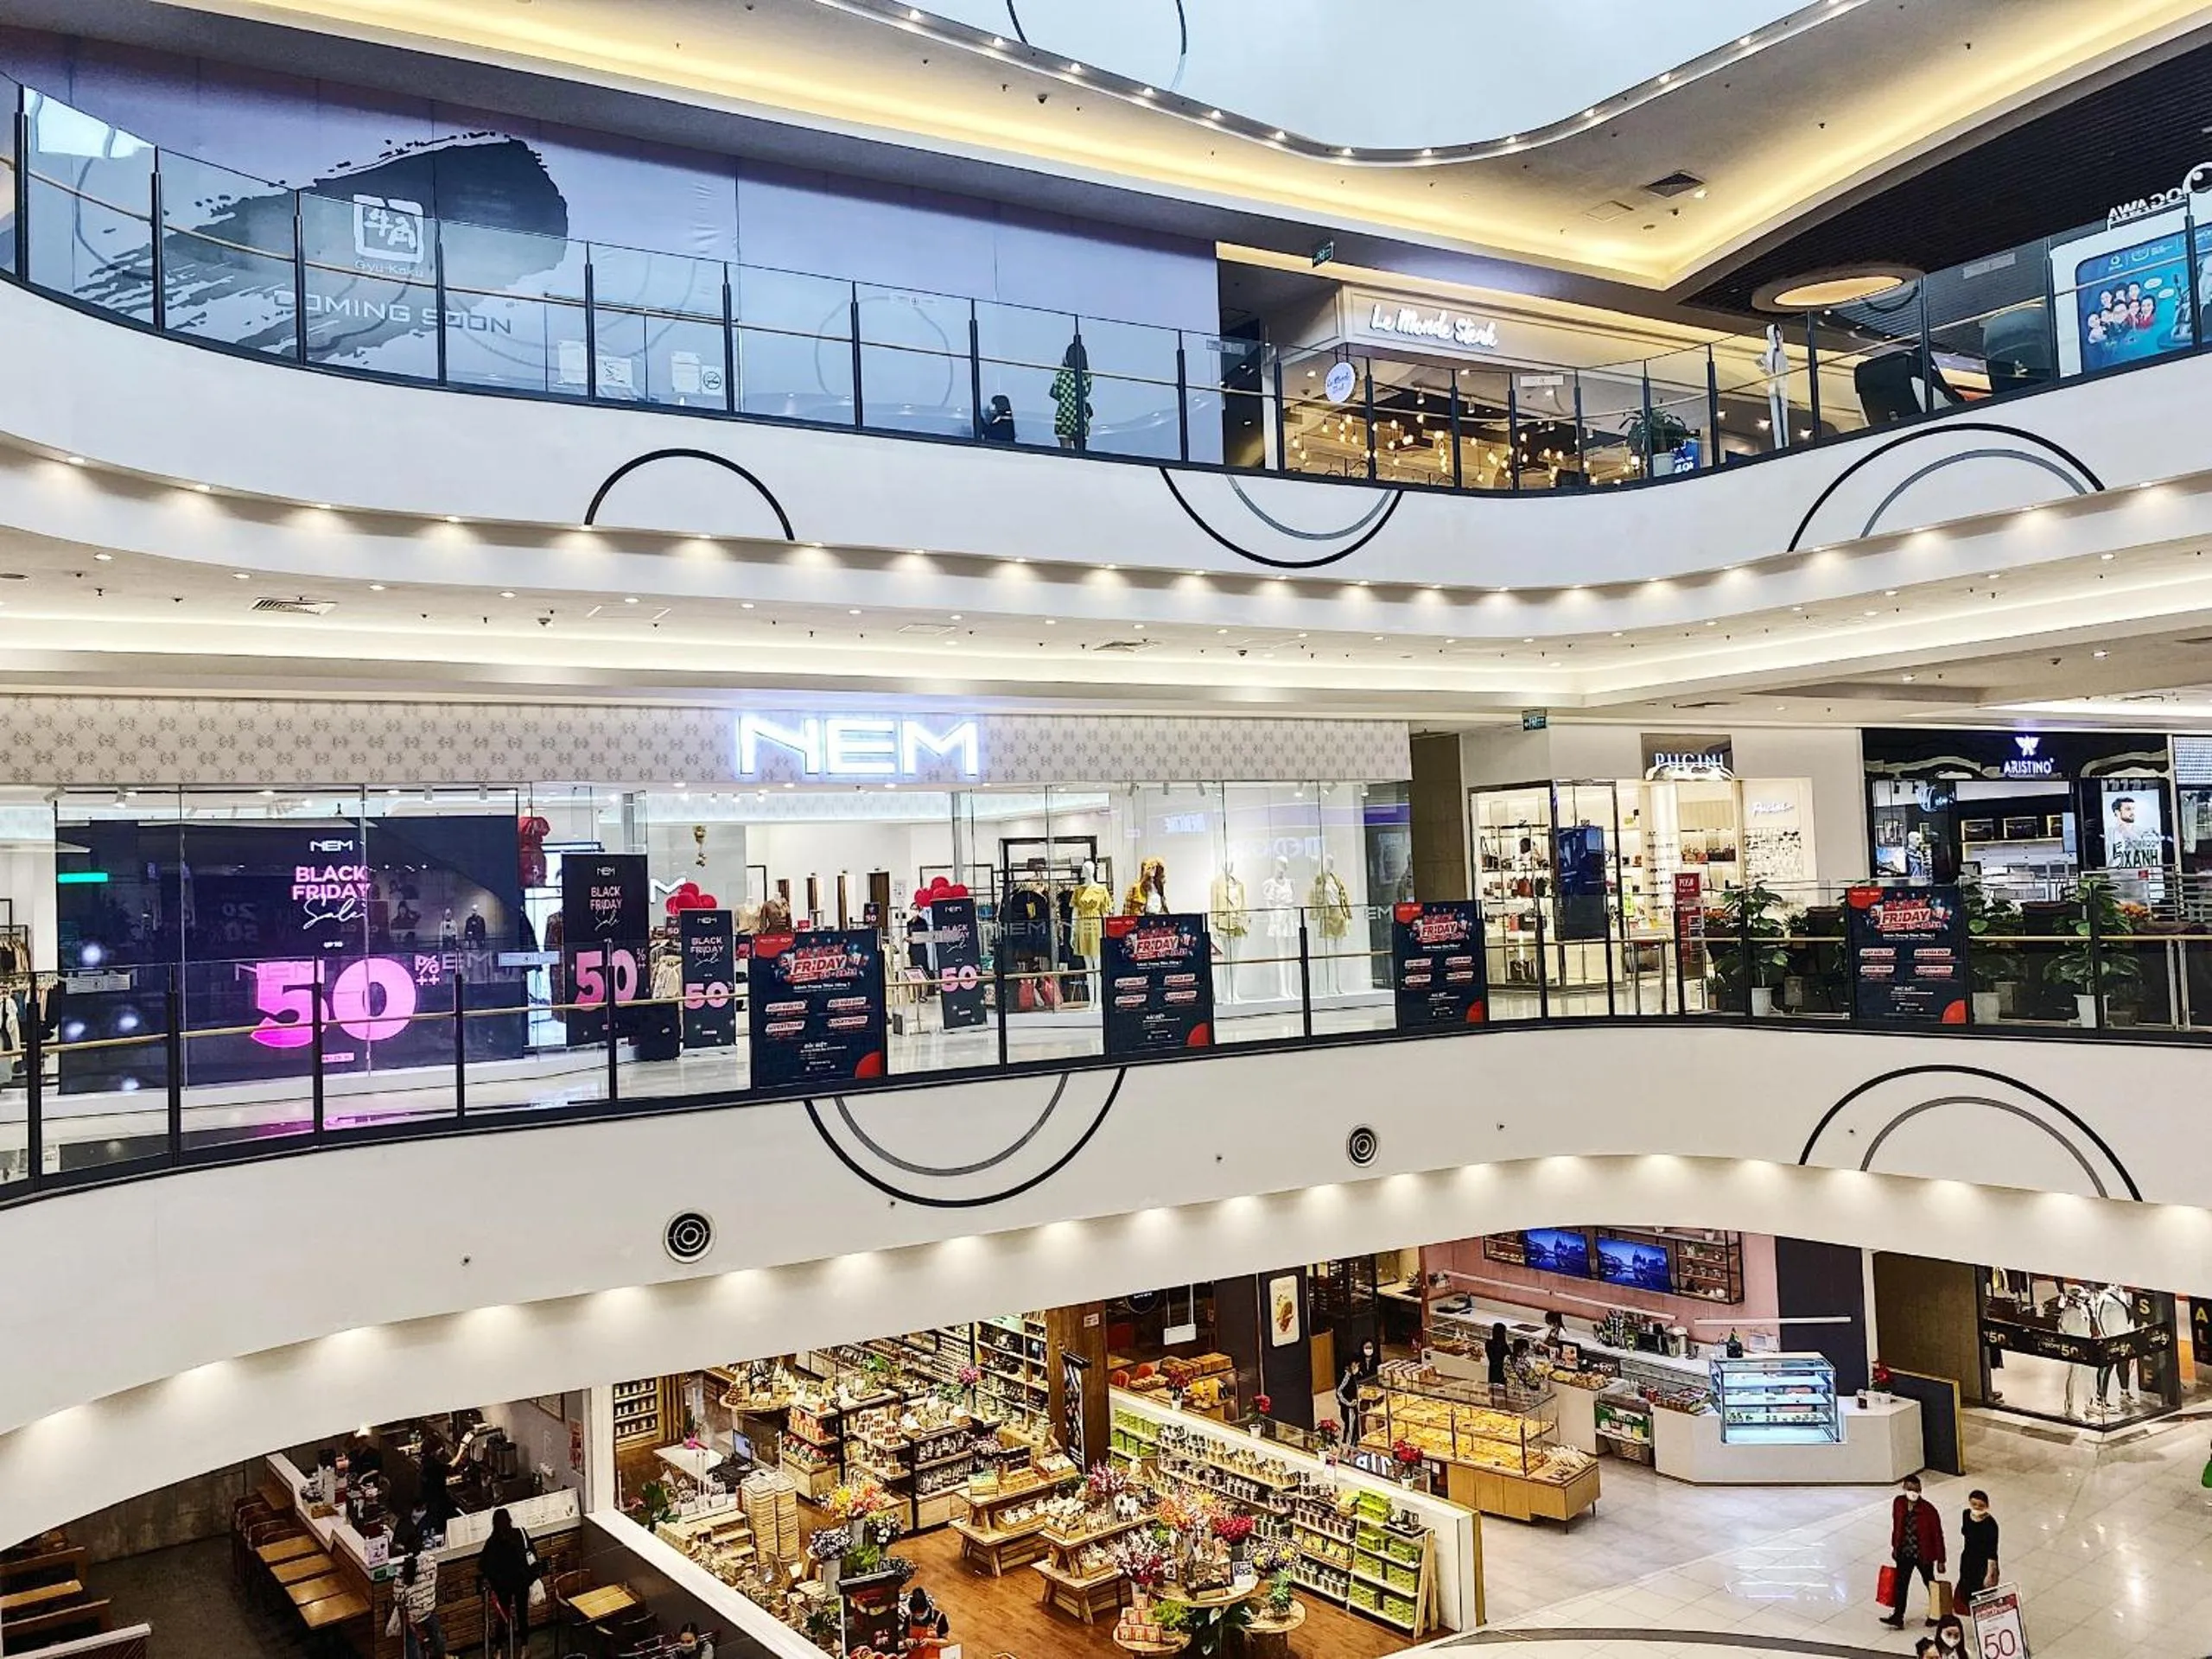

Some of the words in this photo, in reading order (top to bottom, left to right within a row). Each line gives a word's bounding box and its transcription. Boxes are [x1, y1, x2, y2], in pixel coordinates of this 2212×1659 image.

[274, 289, 410, 323] COMING
[422, 307, 512, 334] SOON
[1370, 303, 1395, 332] Le
[739, 715, 978, 776] NEM
[2004, 759, 2052, 775] ARISTINO
[309, 840, 353, 852] NEM
[296, 865, 368, 883] BLACK
[292, 883, 371, 900] FRIDAY
[591, 886, 620, 897] BLACK
[590, 899, 622, 911] FRIDAY
[1882, 910, 1929, 924] FRIDAY
[690, 944, 724, 955] FRIDAY
[691, 936, 722, 945] BLACK
[1136, 938, 1178, 951] FRIDAY
[793, 956, 844, 974] FRIDAY
[575, 949, 638, 1011] 50
[941, 964, 978, 993] 50
[251, 957, 416, 1047] 50
[683, 982, 729, 1009] 50
[1984, 1629, 2016, 1659] 50
